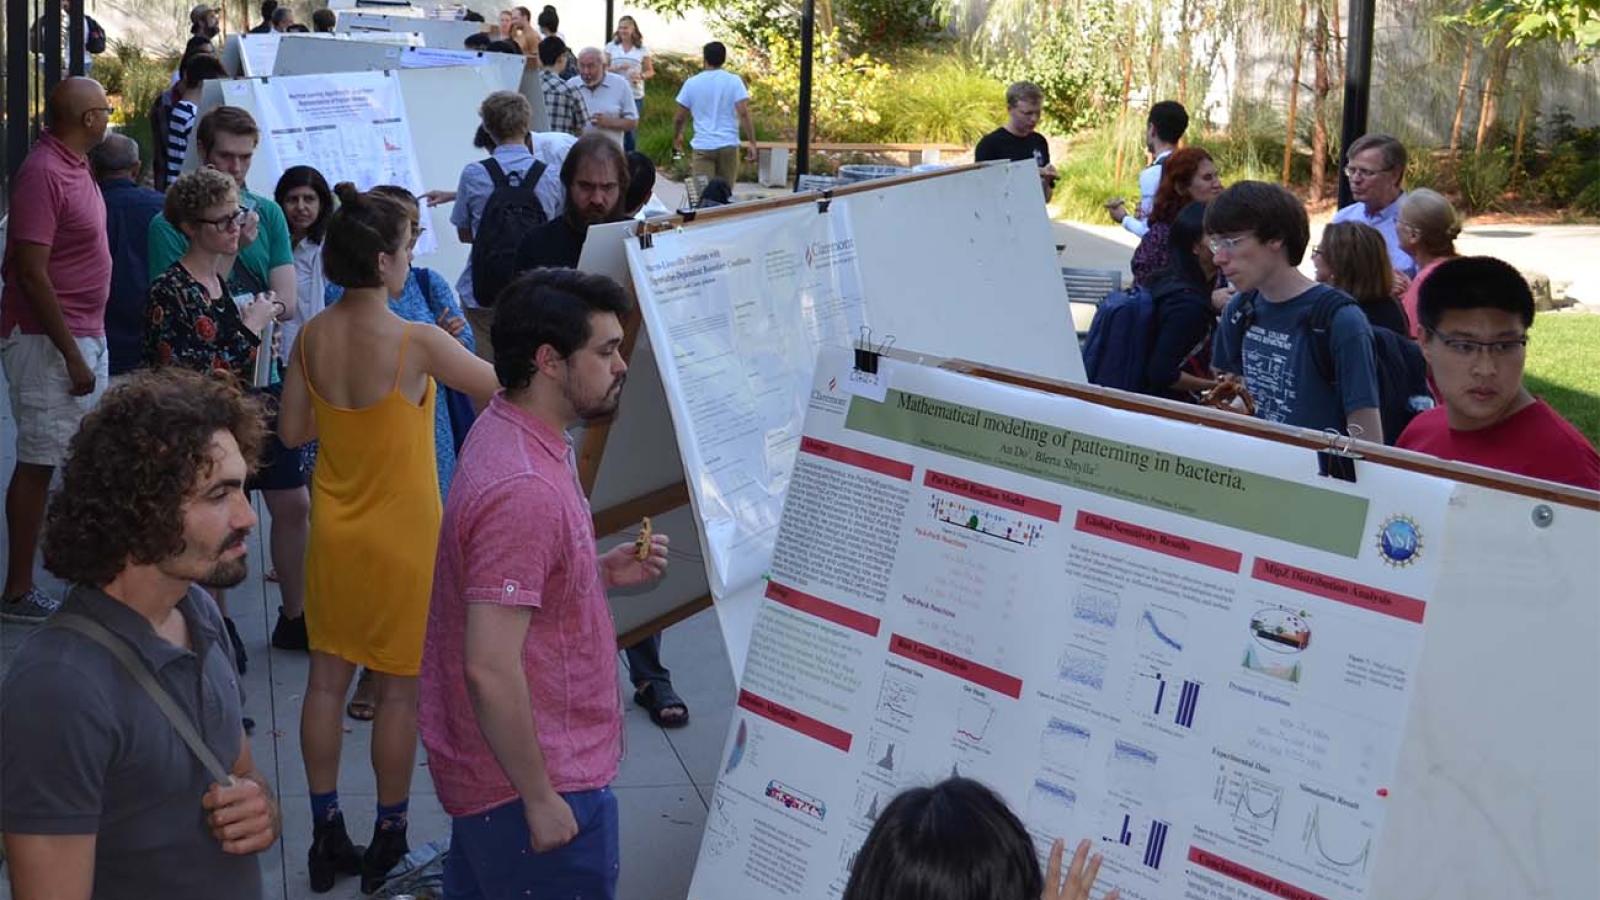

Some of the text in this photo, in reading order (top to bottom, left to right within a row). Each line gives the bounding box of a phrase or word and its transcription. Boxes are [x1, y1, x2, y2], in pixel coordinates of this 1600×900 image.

[898, 392, 1246, 492] Mathematical modeling of patterning in bacteria.
[1002, 494, 1024, 506] Model
[1085, 515, 1190, 551] Global Sensitivity Results
[1263, 562, 1392, 605] MipZ Distribution Analysis
[1212, 747, 1271, 774] Experimental Data
[1299, 782, 1336, 802] Simulation
[1198, 852, 1252, 882] Conclusions
